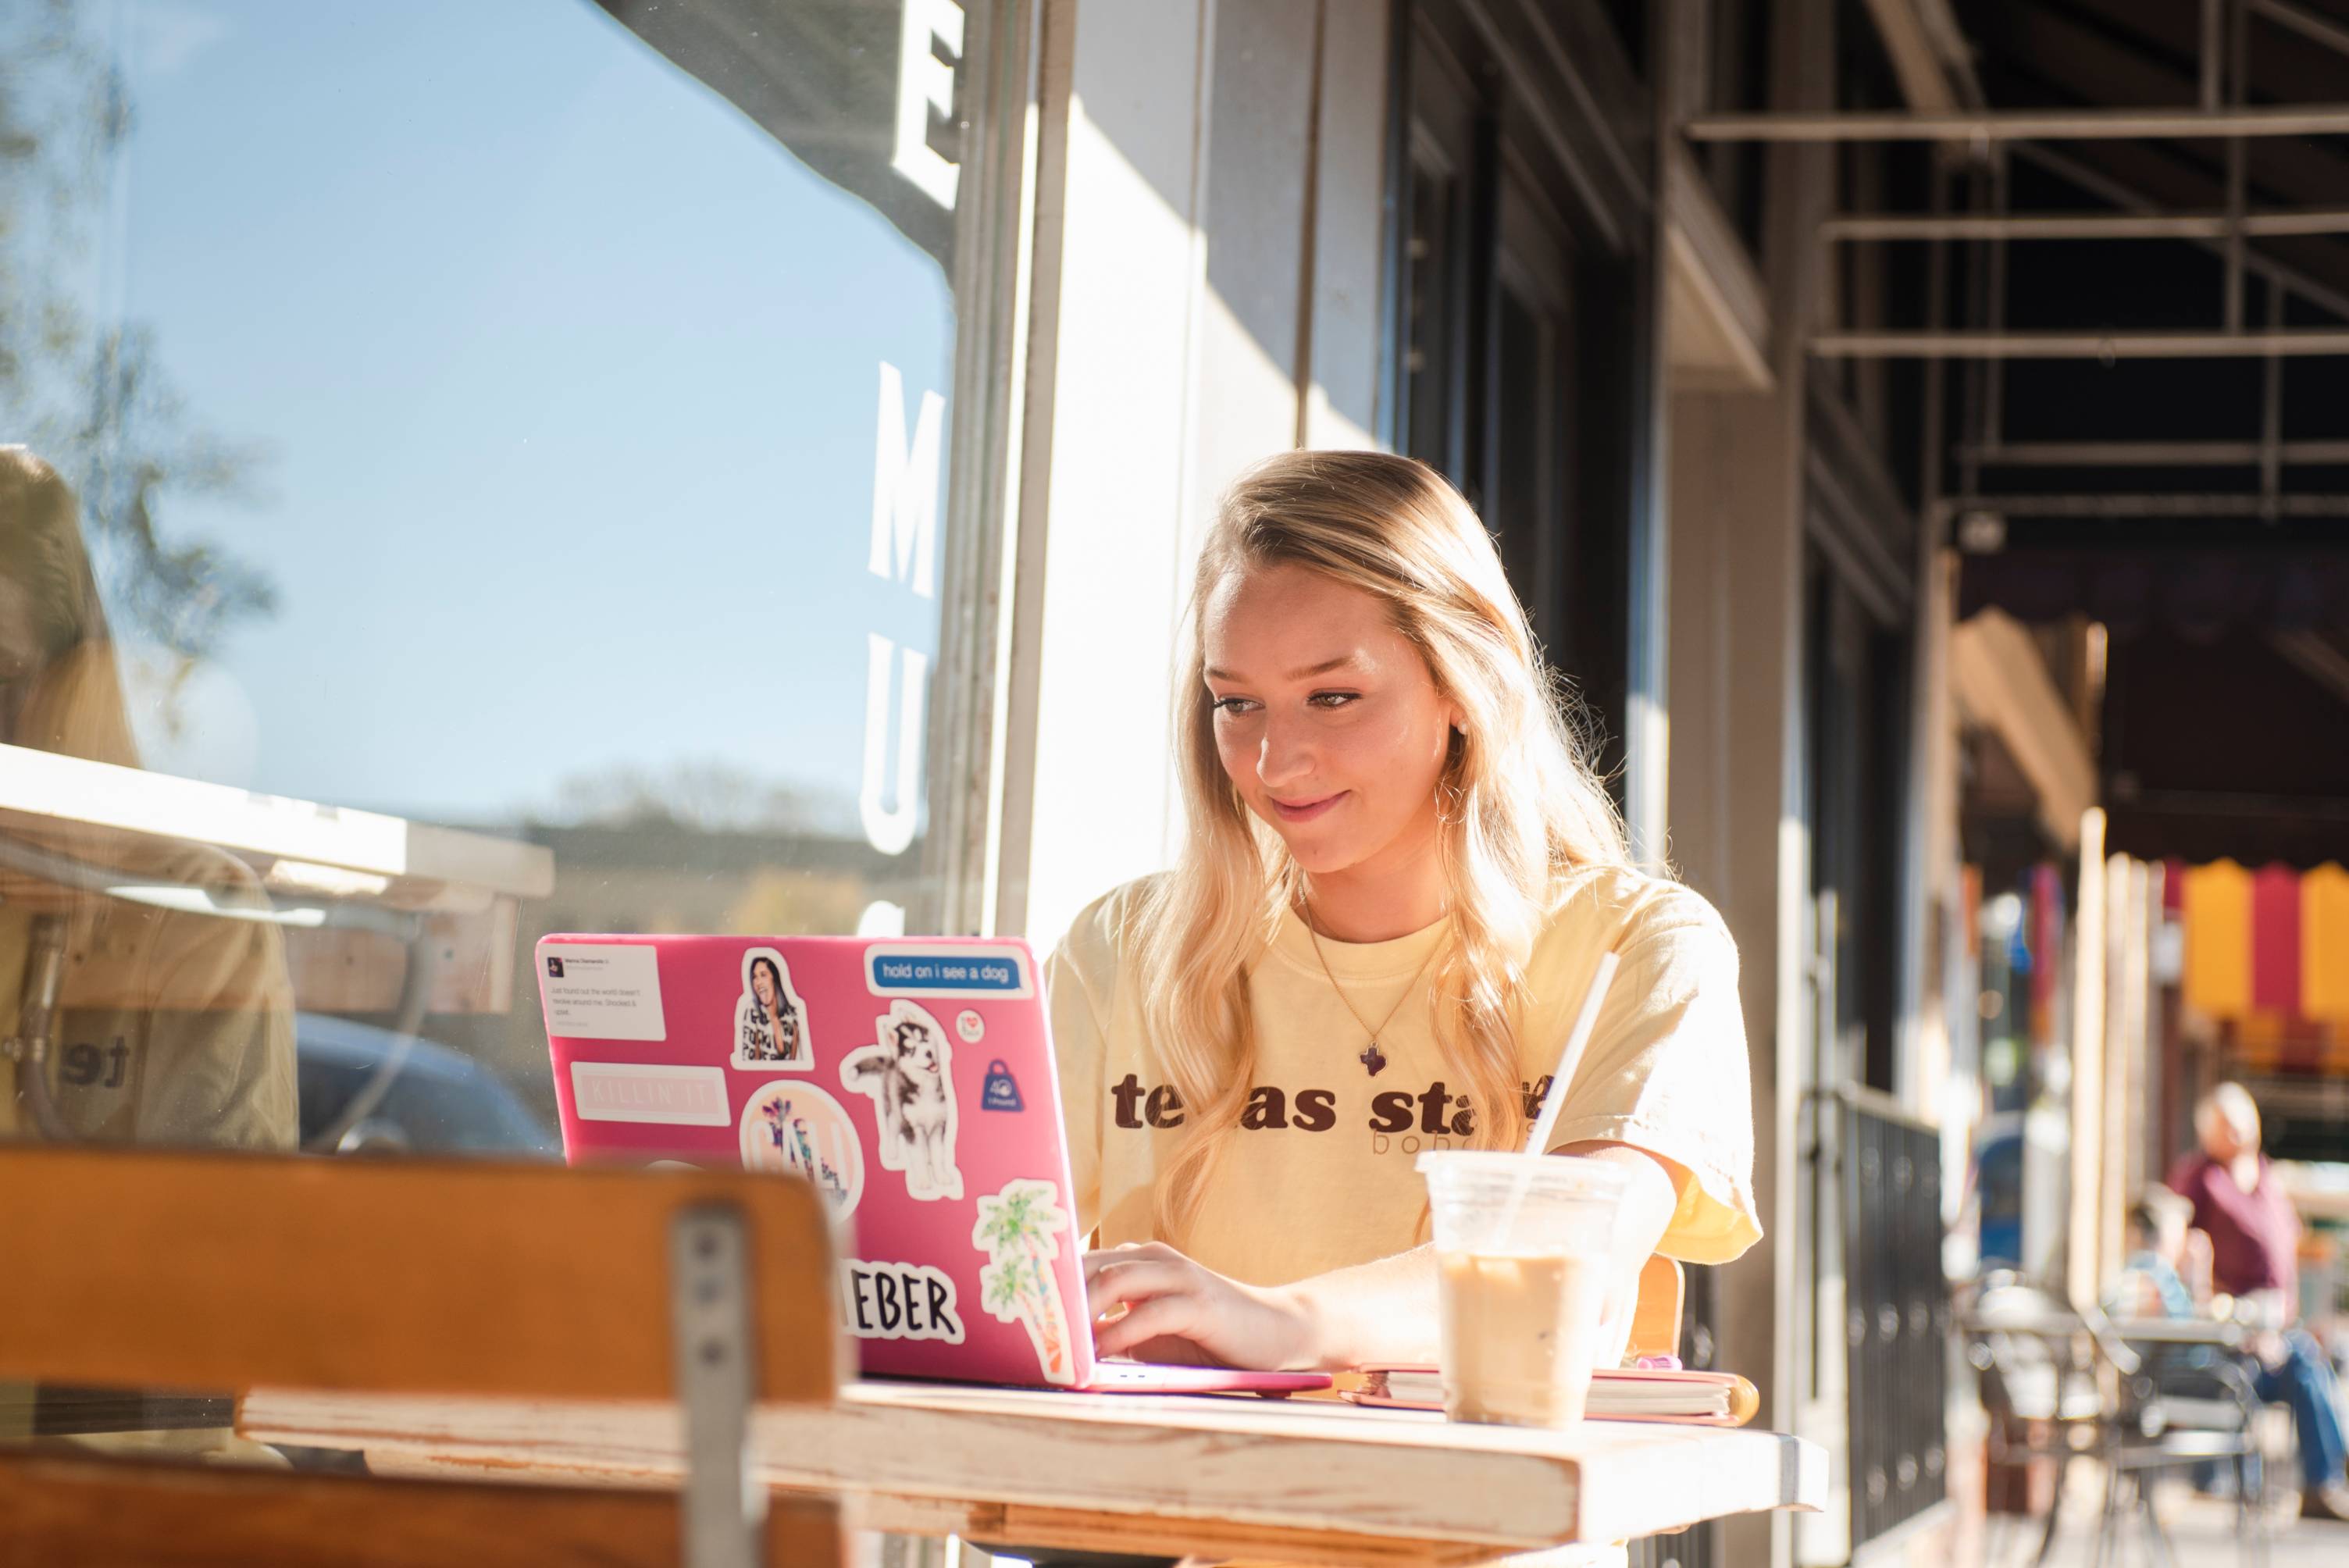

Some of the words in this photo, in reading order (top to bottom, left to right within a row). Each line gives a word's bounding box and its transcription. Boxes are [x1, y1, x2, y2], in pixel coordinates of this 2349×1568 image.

[882, 964, 912, 978] hold
[914, 967, 932, 978] on
[935, 964, 939, 978] i
[942, 967, 966, 979] see
[969, 968, 978, 979] a
[981, 965, 1009, 984] dog
[591, 1080, 674, 1105] KILLIN'
[685, 1084, 708, 1107] IT
[1110, 1073, 1336, 1132] teas
[1368, 1074, 1556, 1135] stae
